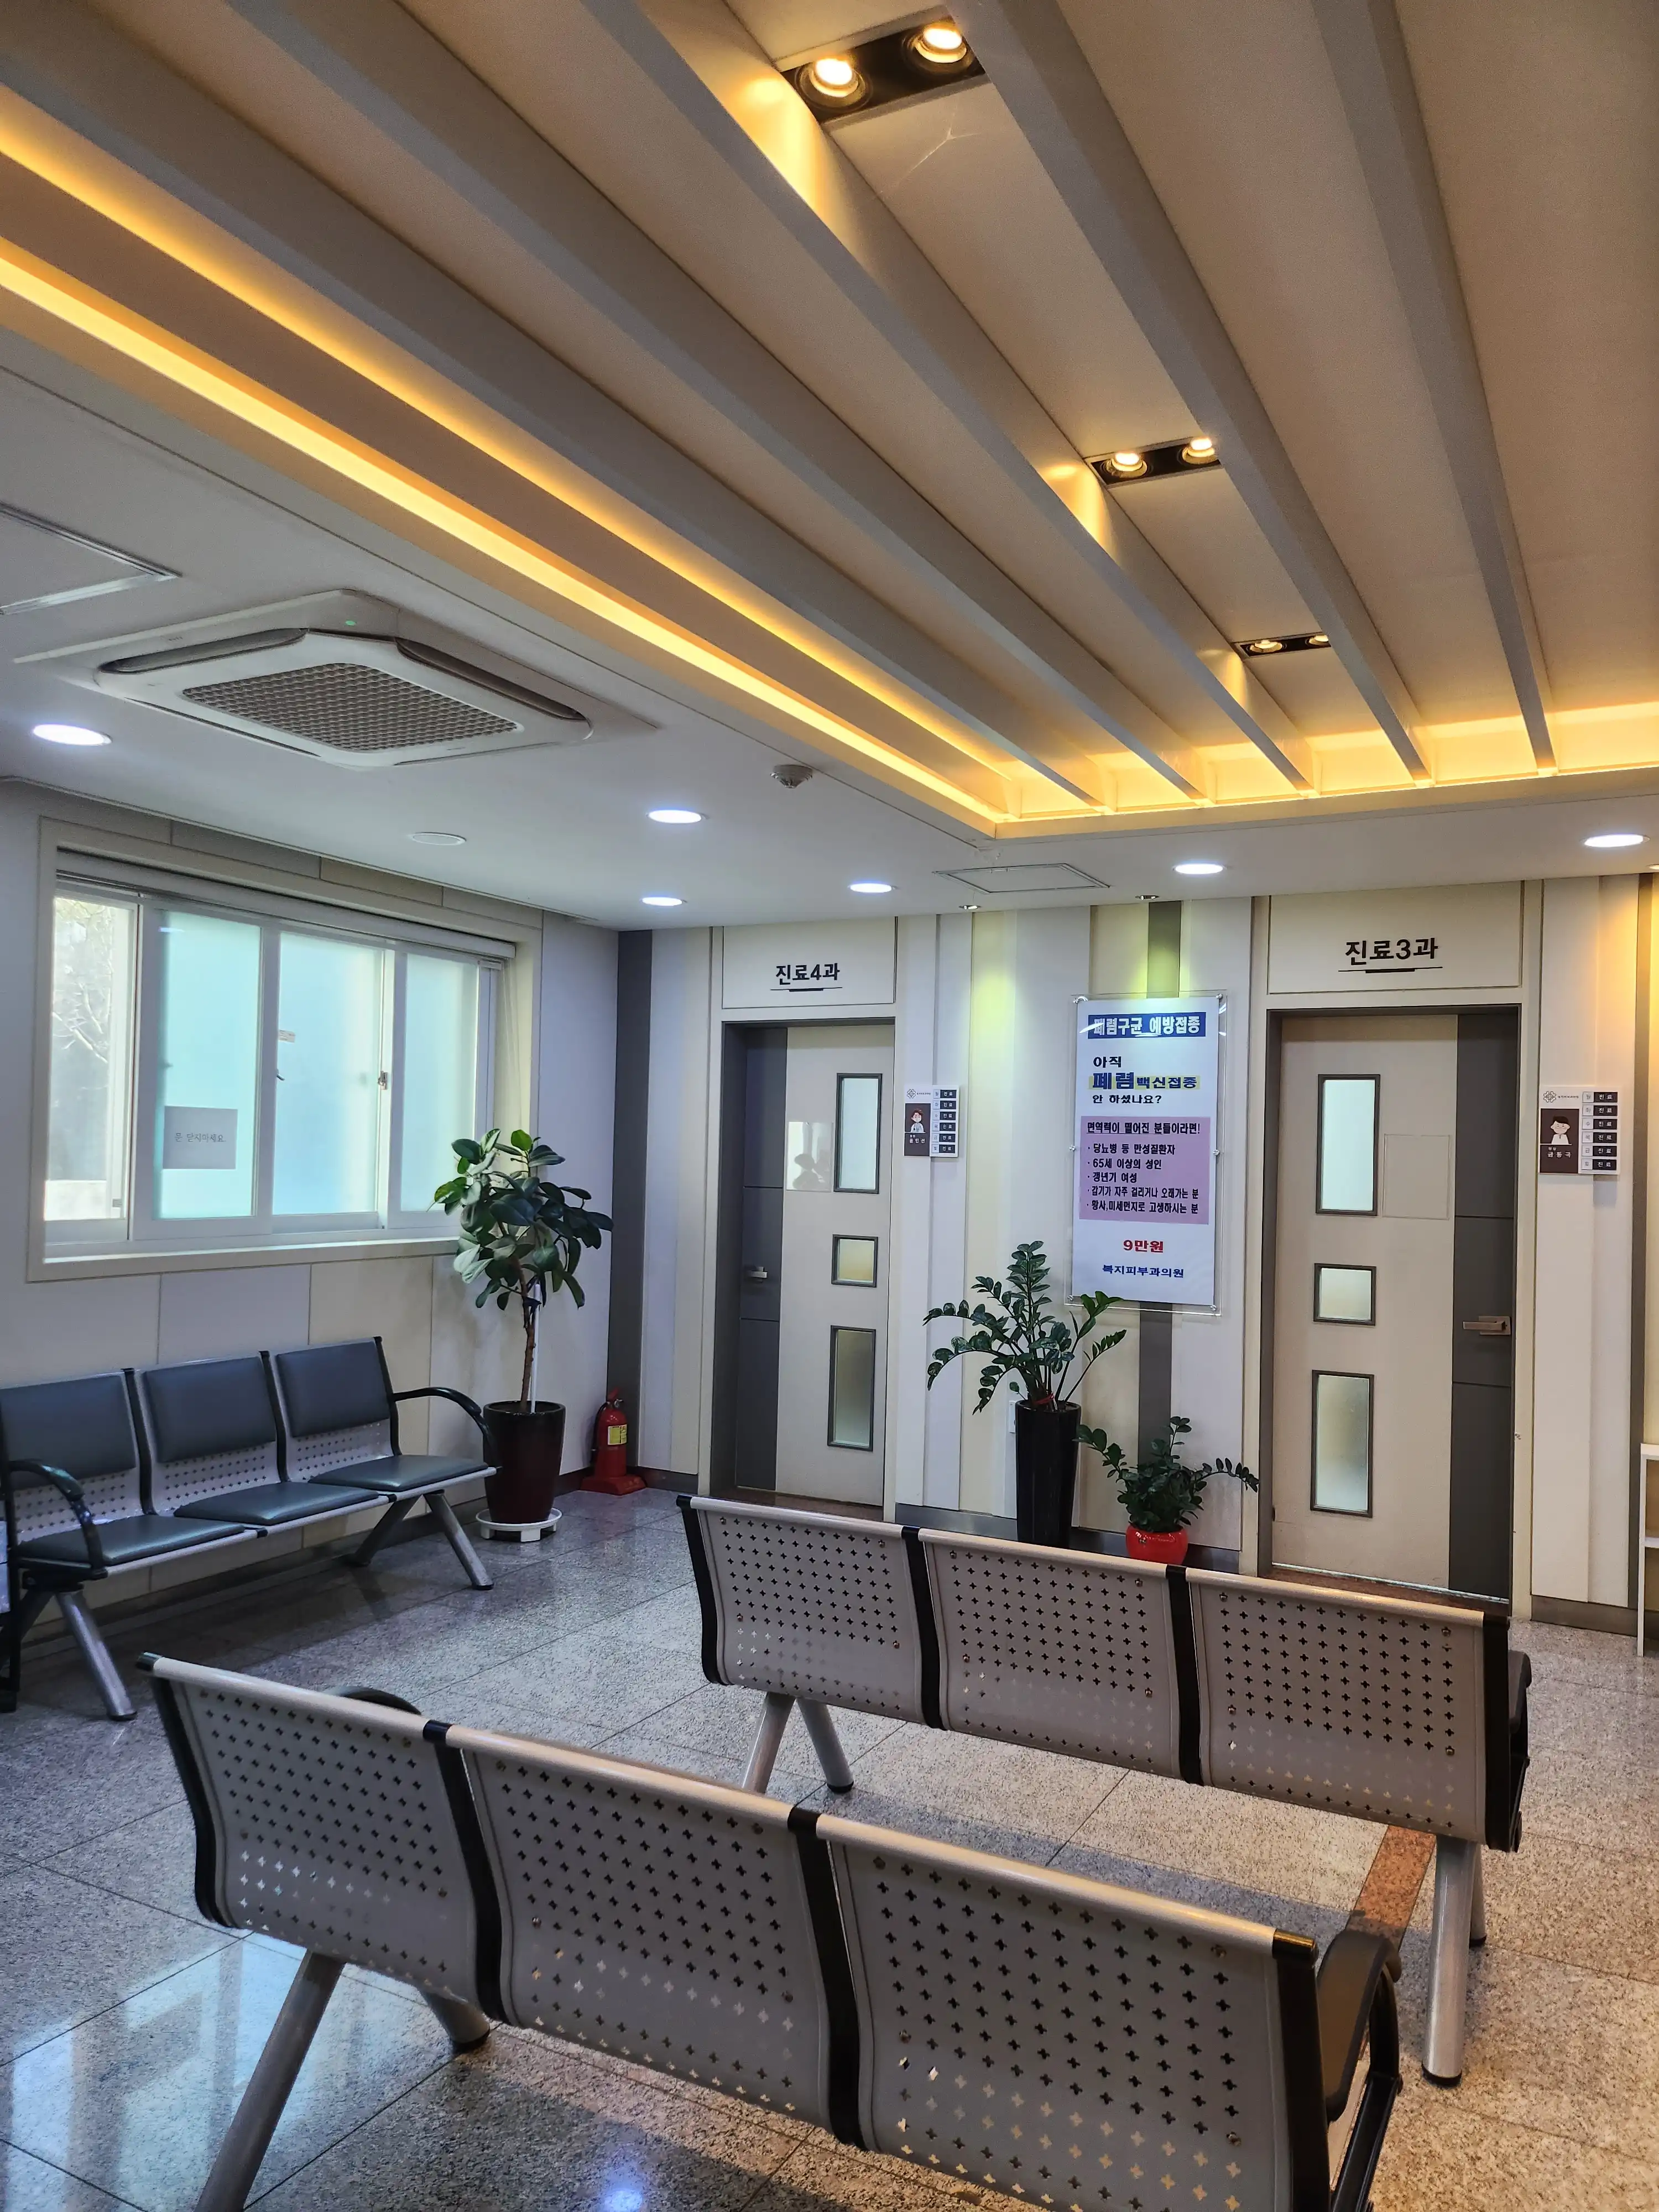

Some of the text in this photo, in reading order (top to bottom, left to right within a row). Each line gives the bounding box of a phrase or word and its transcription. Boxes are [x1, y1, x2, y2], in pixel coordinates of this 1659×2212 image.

[1345, 938, 1439, 965] 진료3과
[776, 963, 840, 985] 진료4과
[1094, 1016, 1200, 1035] 폐렴구균 예방접종
[1093, 1056, 1121, 1068] 아직
[1093, 1095, 1162, 1104] 안 하셨나요?
[1087, 1122, 1200, 1134] 면역력이 떨어진 분들이라면!
[175, 1133, 182, 1142] 문
[1093, 1143, 1176, 1155] 당뇨병 등 만성질환자
[1093, 1158, 1162, 1170] 65세 이상의 성인
[1093, 1172, 1137, 1183] 갱년기 여성
[1114, 1186, 1128, 1197] 자주
[1131, 1187, 1158, 1197] 걸리거나
[1161, 1187, 1188, 1199] 오래가는
[1192, 1188, 1198, 1199] 분
[1149, 1202, 1187, 1213] 고생하시는
[1191, 1203, 1198, 1214] 분
[1123, 1240, 1164, 1253] 9만원
[1102, 1265, 1184, 1278] 복지피부과의원
